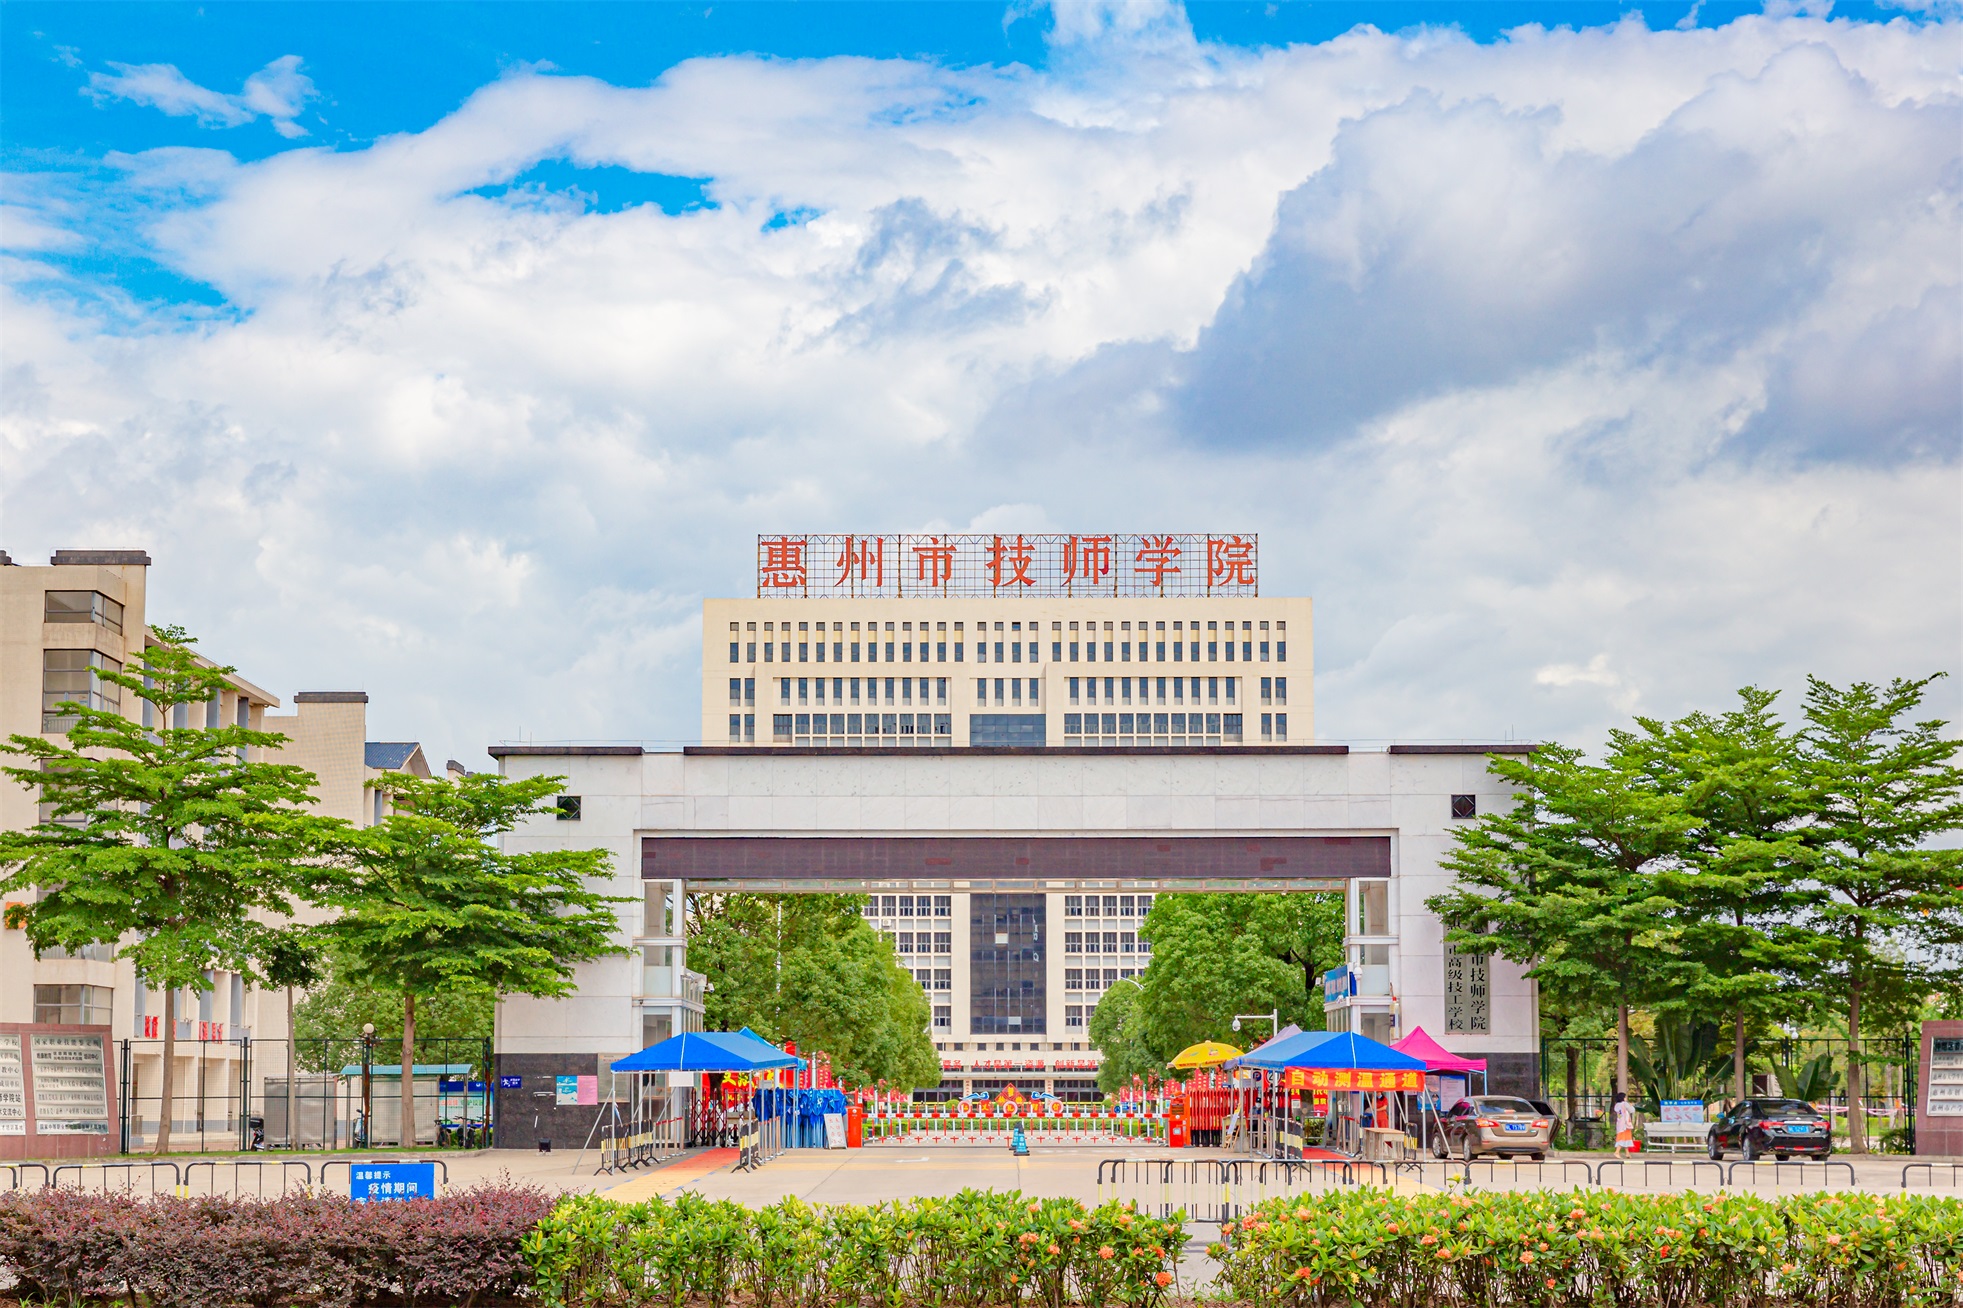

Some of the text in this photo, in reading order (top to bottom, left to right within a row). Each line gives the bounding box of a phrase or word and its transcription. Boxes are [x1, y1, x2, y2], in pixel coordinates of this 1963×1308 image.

[760, 535, 1255, 587] 惠州市技师学院
[1470, 921, 1487, 1030] 市技师学院
[972, 1059, 1044, 1069] 人才是第一资源
[1291, 1070, 1418, 1088] 自动测温通道
[355, 1170, 391, 1180] 温馨提示
[368, 1181, 418, 1195] 疫情期间
